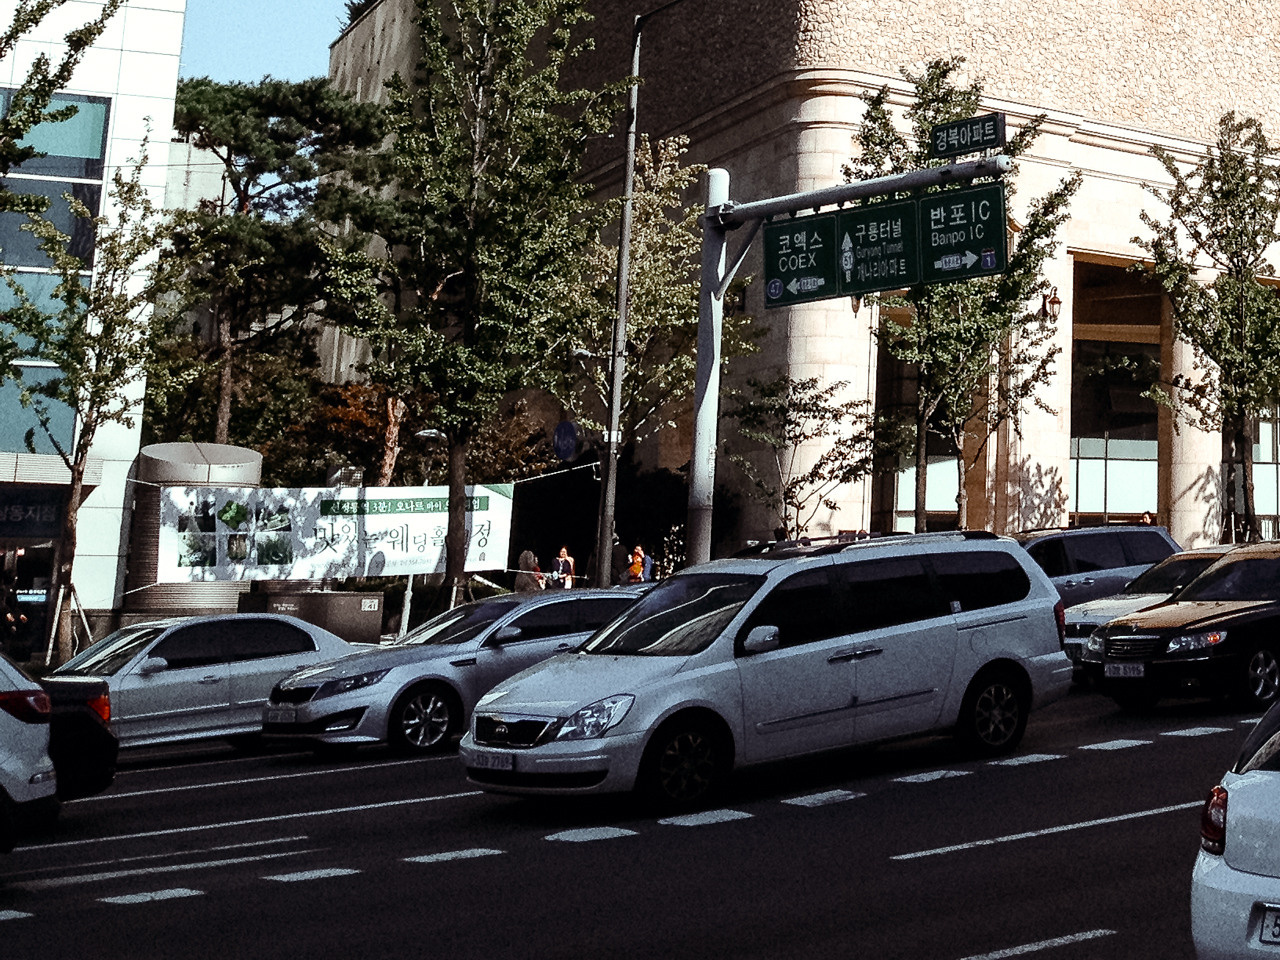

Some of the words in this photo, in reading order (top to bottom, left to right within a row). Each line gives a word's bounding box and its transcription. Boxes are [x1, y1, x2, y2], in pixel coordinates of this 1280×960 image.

[936, 121, 996, 151] 경복아파트
[778, 231, 824, 254] 코엑스
[855, 218, 902, 244] 구룡터널
[931, 230, 966, 247] Banpo
[970, 224, 985, 240] IC
[778, 252, 817, 272] COEX
